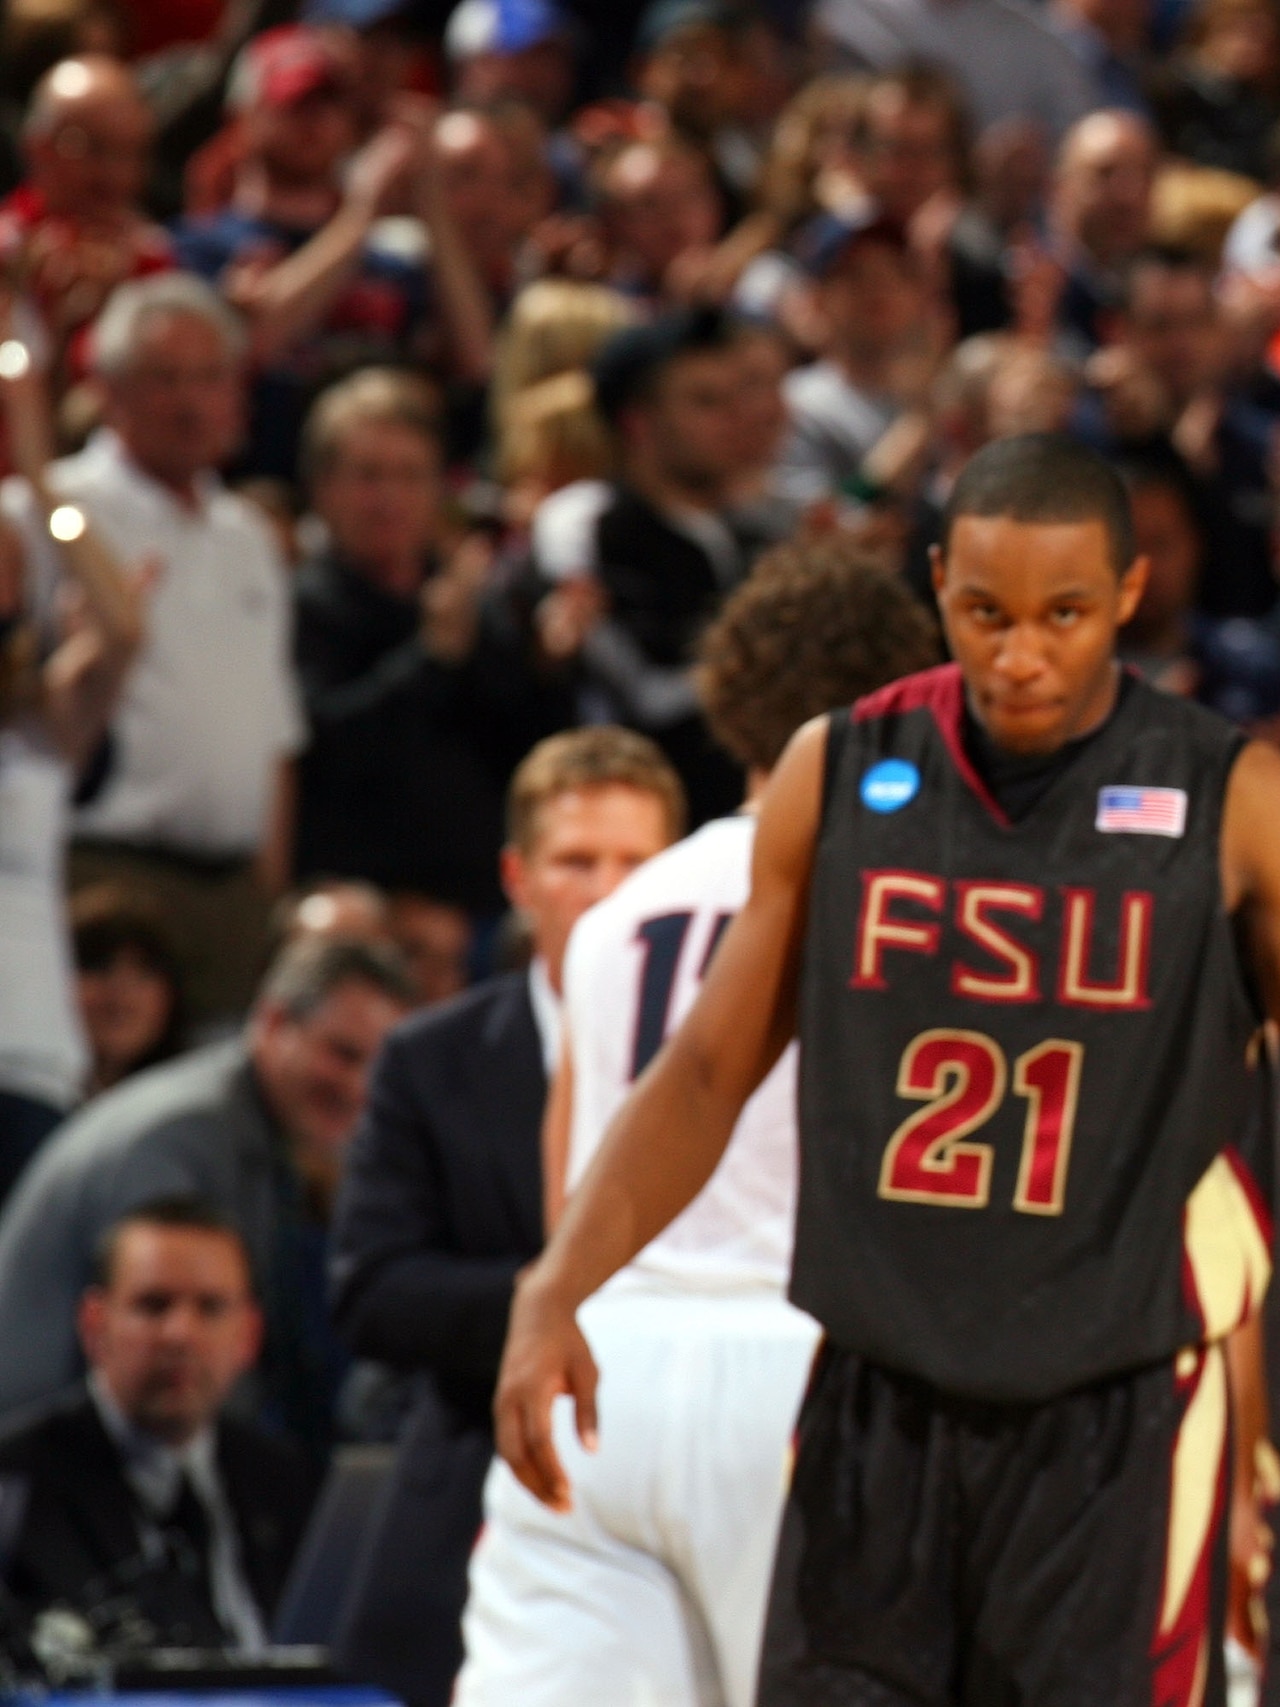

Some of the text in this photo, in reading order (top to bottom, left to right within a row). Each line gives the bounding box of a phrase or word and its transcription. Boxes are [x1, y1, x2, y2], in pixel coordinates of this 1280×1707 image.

[627, 909, 736, 1086] 1
[850, 868, 1154, 1012] FSU
[878, 1027, 1084, 1216] 21
